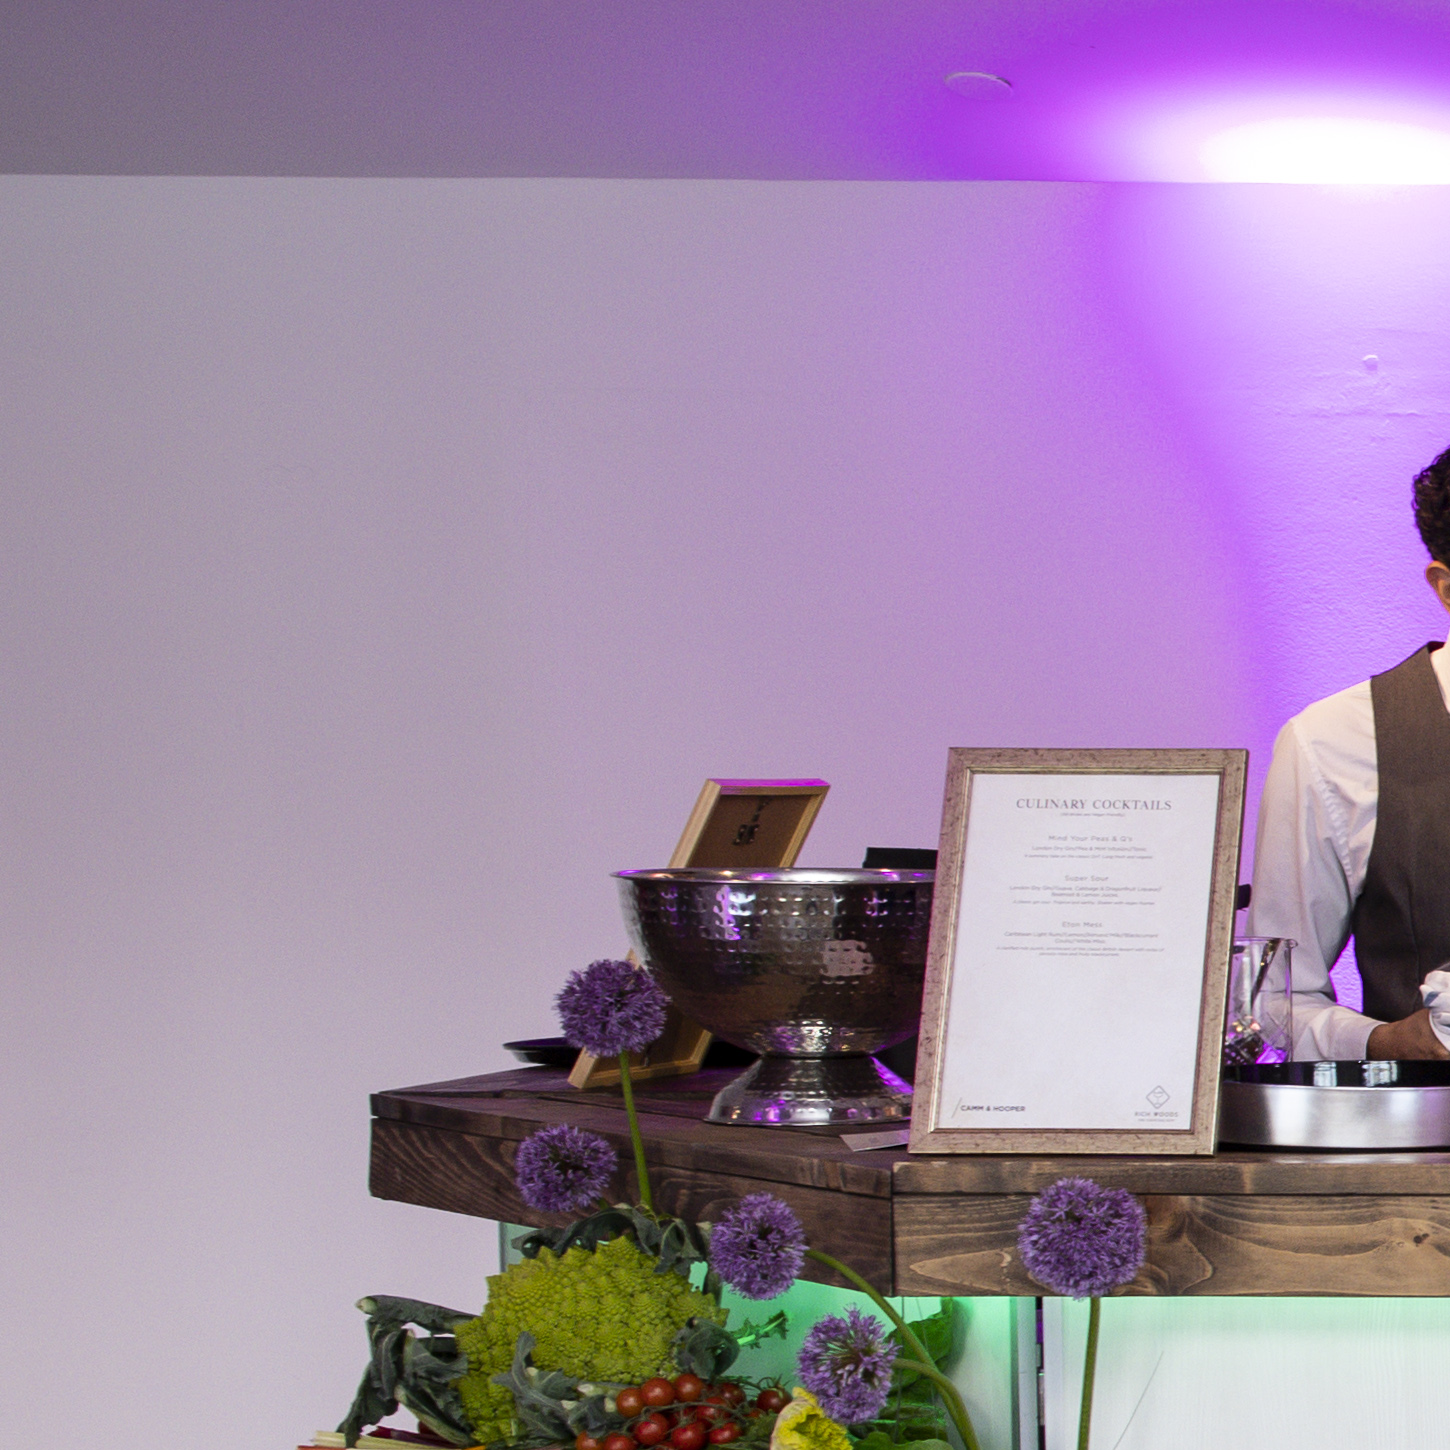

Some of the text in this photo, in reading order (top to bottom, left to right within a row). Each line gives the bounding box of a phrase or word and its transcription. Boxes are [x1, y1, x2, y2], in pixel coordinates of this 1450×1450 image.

[1016, 798, 1172, 810] CULINARY COCKTAILS
[960, 1104, 984, 1112] CAMM
